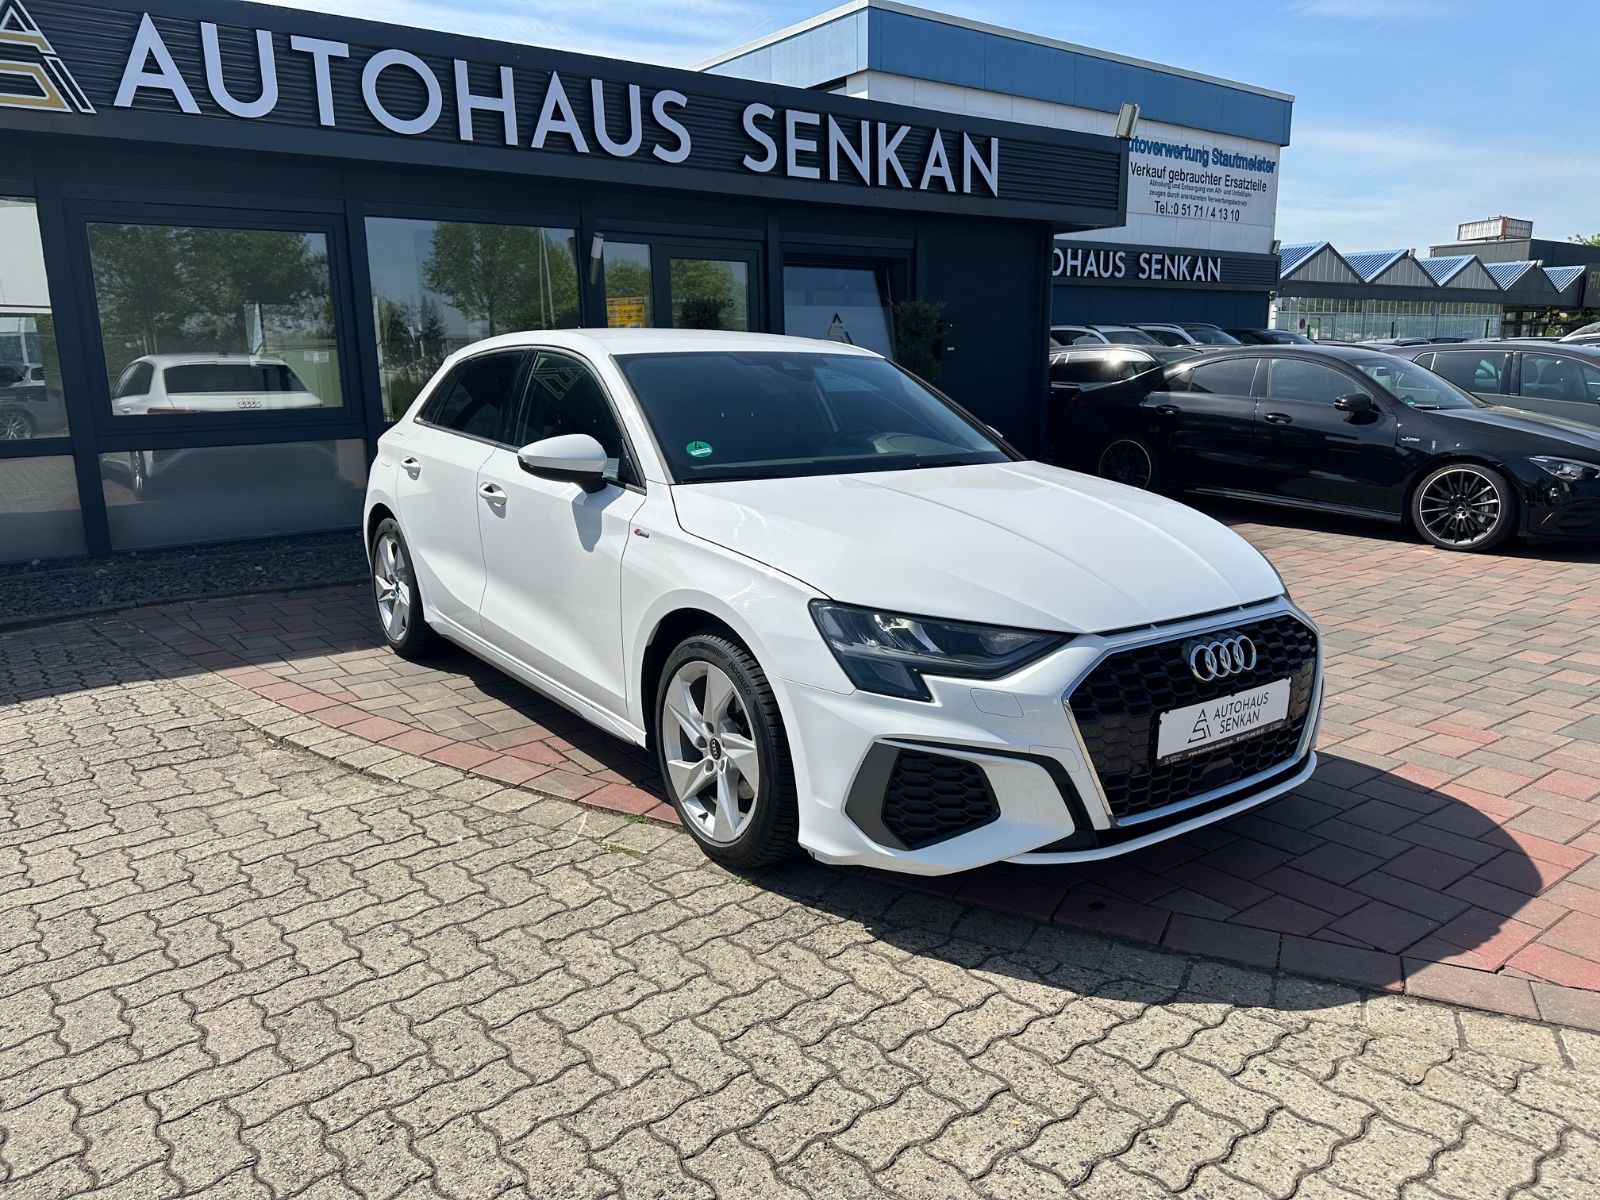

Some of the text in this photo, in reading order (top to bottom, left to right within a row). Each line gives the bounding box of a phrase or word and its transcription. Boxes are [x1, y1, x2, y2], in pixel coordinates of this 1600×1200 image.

[113, 12, 999, 197] AUTOHAUS SENKAN
[1129, 136, 1276, 174] utoverwertung Stautmeister
[1130, 162, 1267, 193] Verkauf gebrauchter Ersatzteile
[1149, 180, 1171, 190] Abholung
[1181, 183, 1206, 194] Entsorgung
[1167, 190, 1180, 199] durch
[1181, 203, 1191, 217] 51
[1194, 205, 1203, 218] 71
[1210, 206, 1216, 219] 4
[1218, 208, 1228, 221] 13
[1230, 209, 1240, 222] 10
[1052, 248, 1222, 283] OHAUS SENKAN
[1213, 692, 1269, 720] AUTOHAUS
[1219, 709, 1261, 735] SENKAN
